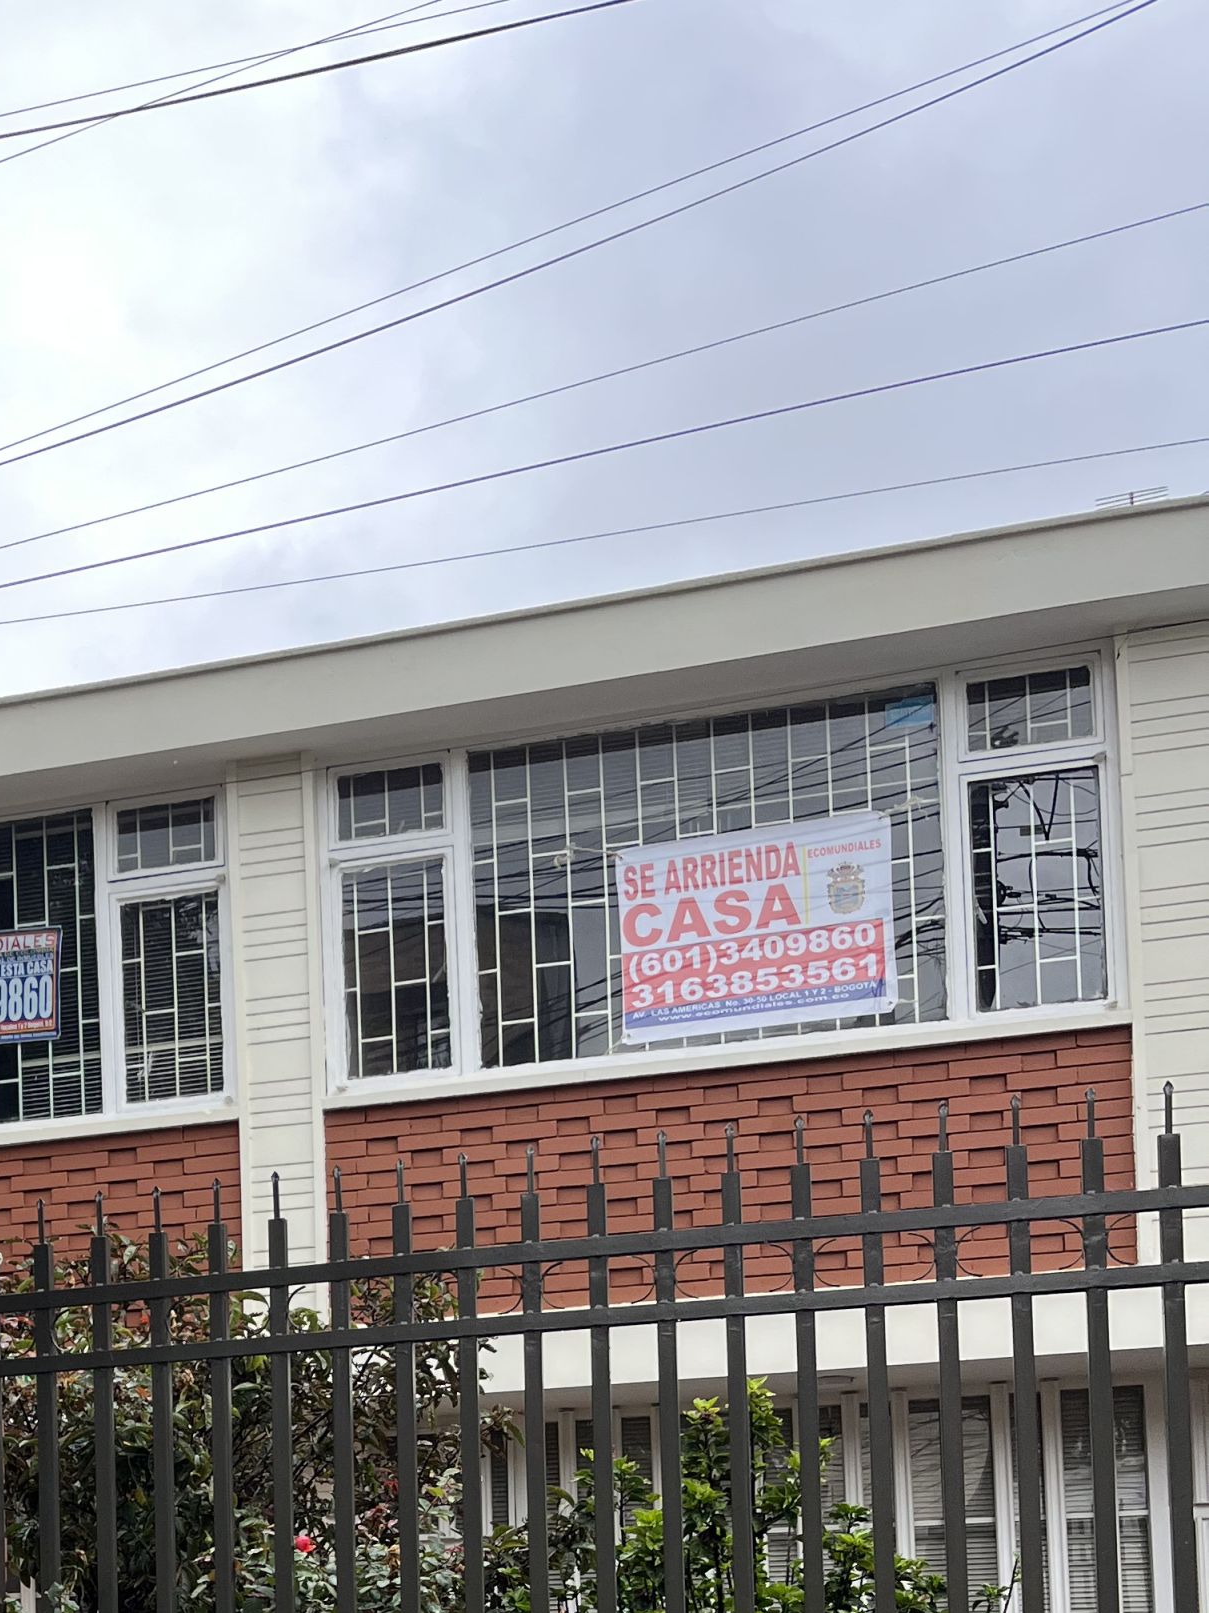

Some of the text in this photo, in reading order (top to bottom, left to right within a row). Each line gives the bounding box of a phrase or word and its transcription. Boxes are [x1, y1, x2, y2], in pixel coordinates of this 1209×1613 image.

[624, 841, 802, 901] SE ARRIENDA
[807, 838, 882, 859] ECOMUNDIALES
[622, 883, 802, 947] CASA
[1, 961, 24, 977] ESTA
[26, 959, 54, 975] CASA
[629, 922, 876, 983] (601)3409860
[631, 953, 878, 1008] 3163853561
[769, 991, 802, 1002] LOCAL
